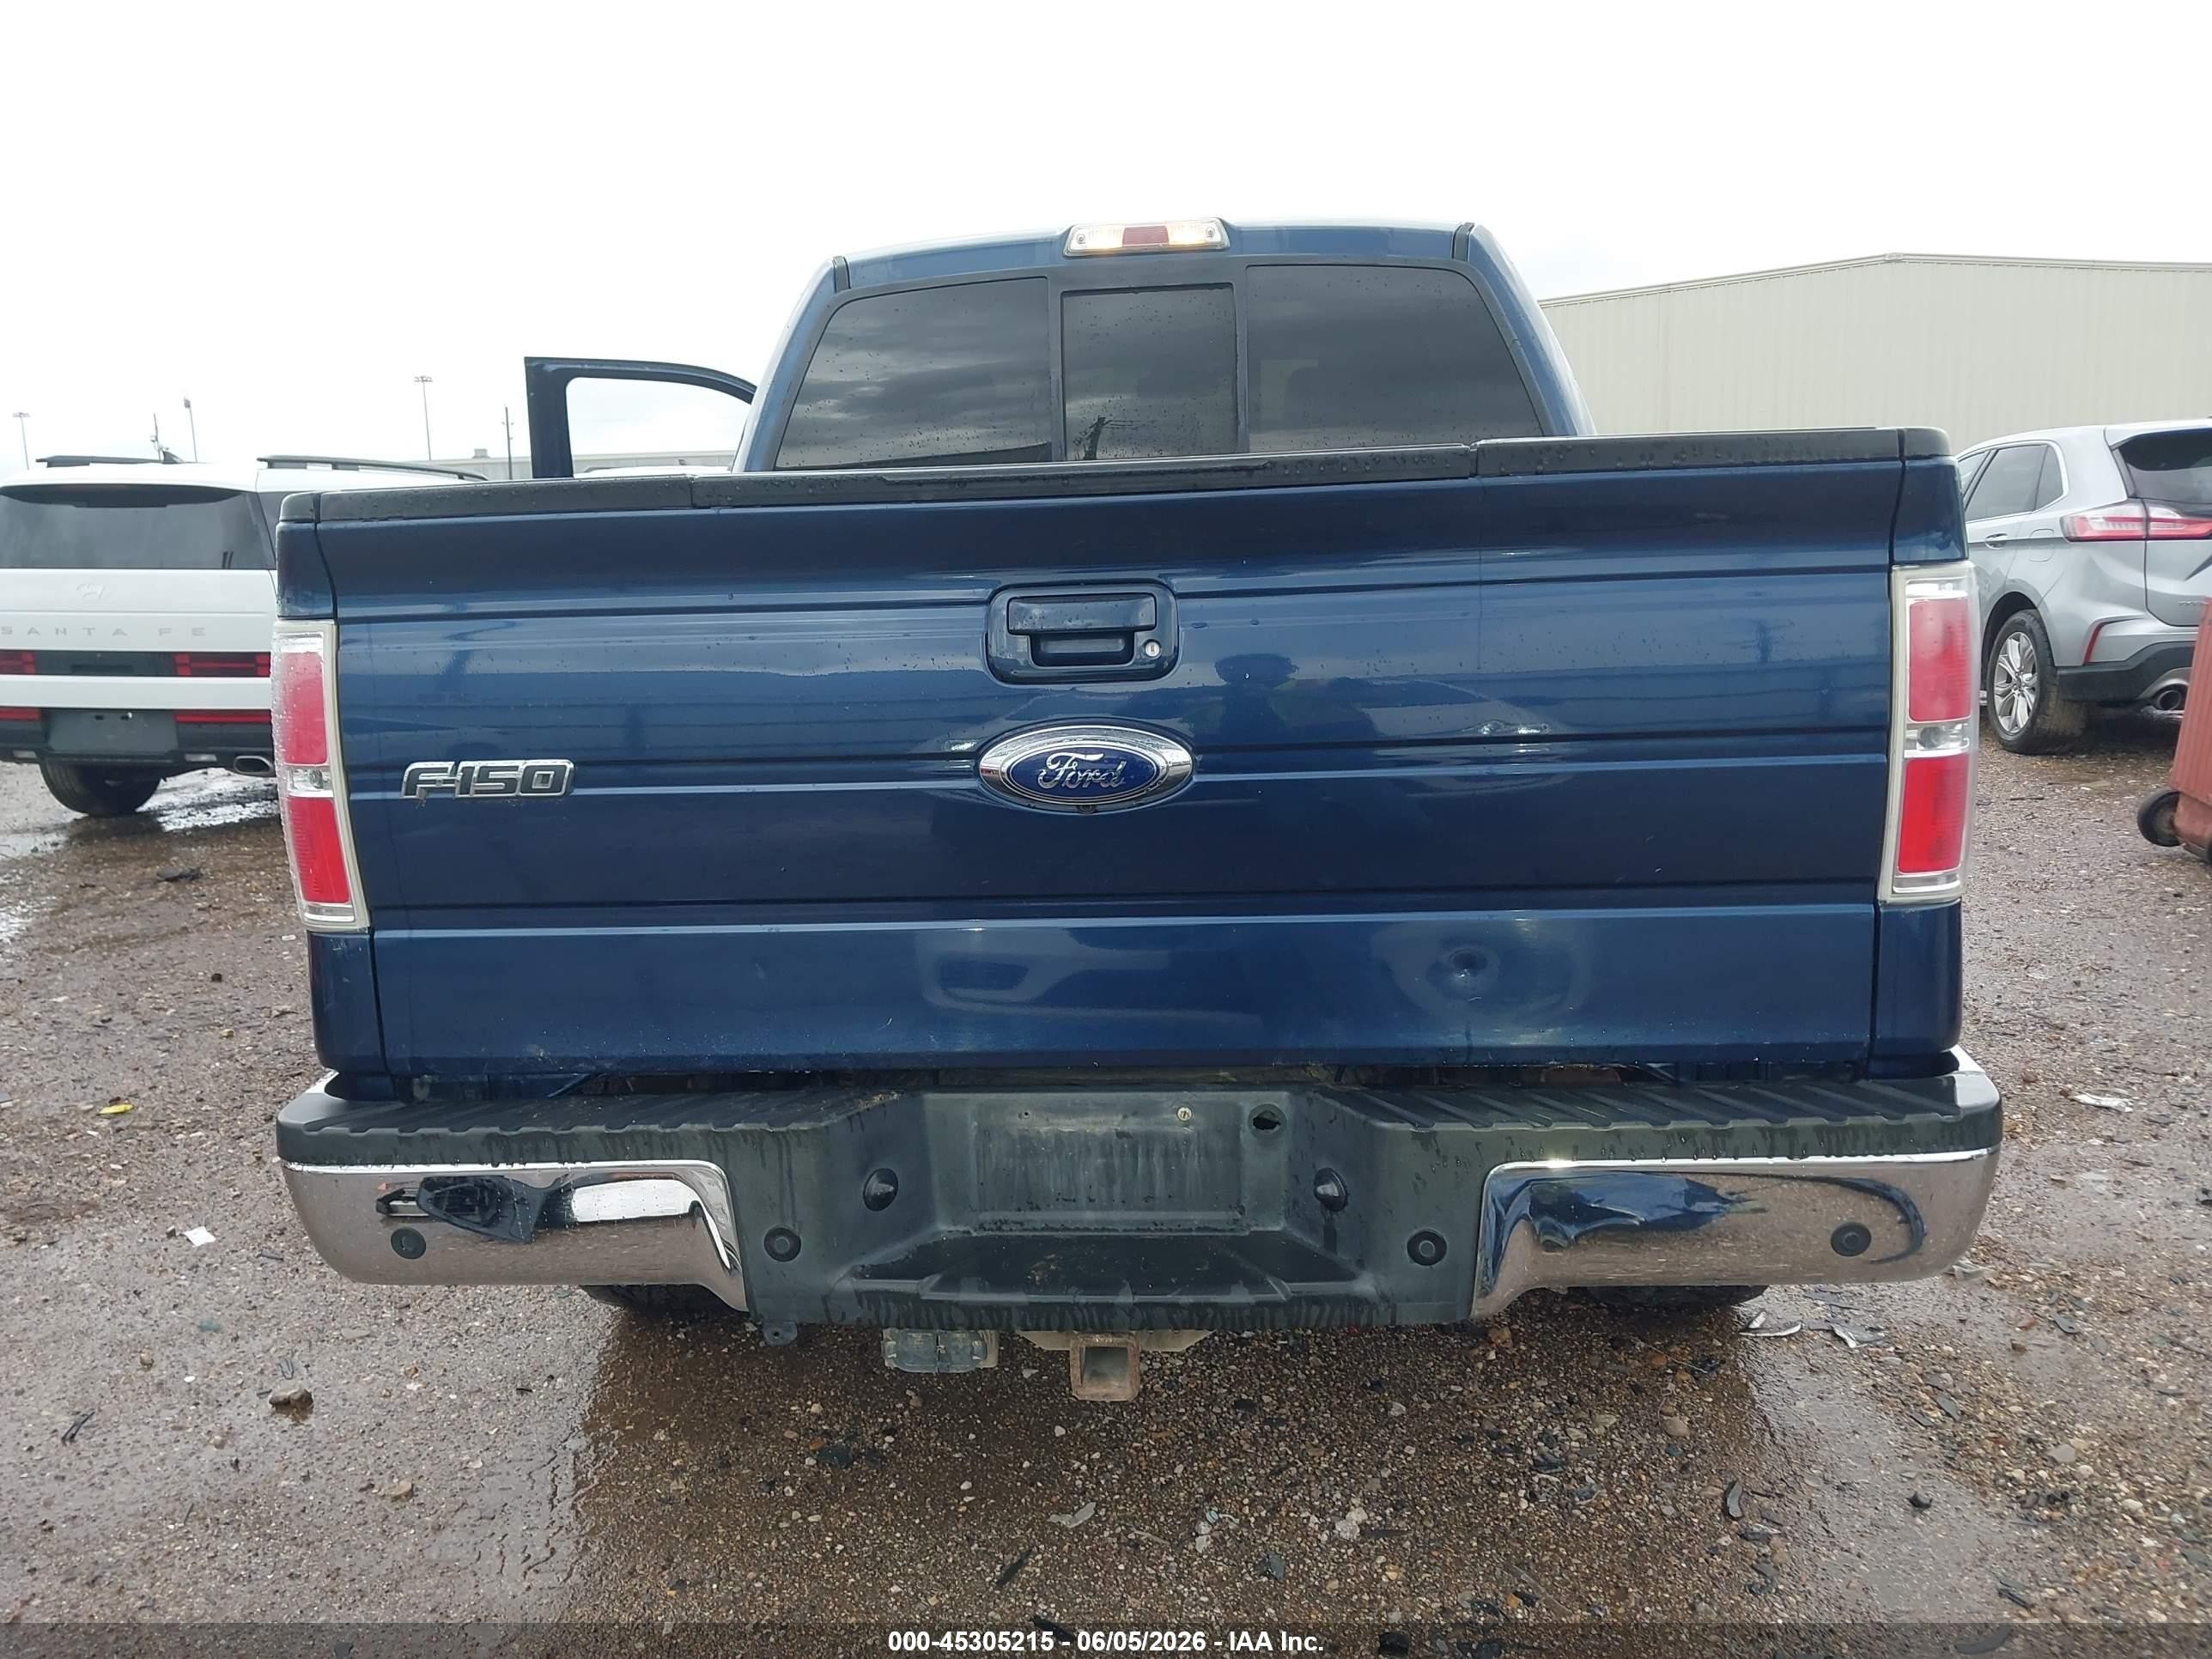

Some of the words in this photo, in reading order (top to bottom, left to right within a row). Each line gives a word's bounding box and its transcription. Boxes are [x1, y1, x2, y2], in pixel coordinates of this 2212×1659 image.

[0, 626, 128, 637] SANTA
[158, 627, 206, 637] FE
[398, 757, 575, 800] F-150
[1036, 751, 1127, 789] Ford
